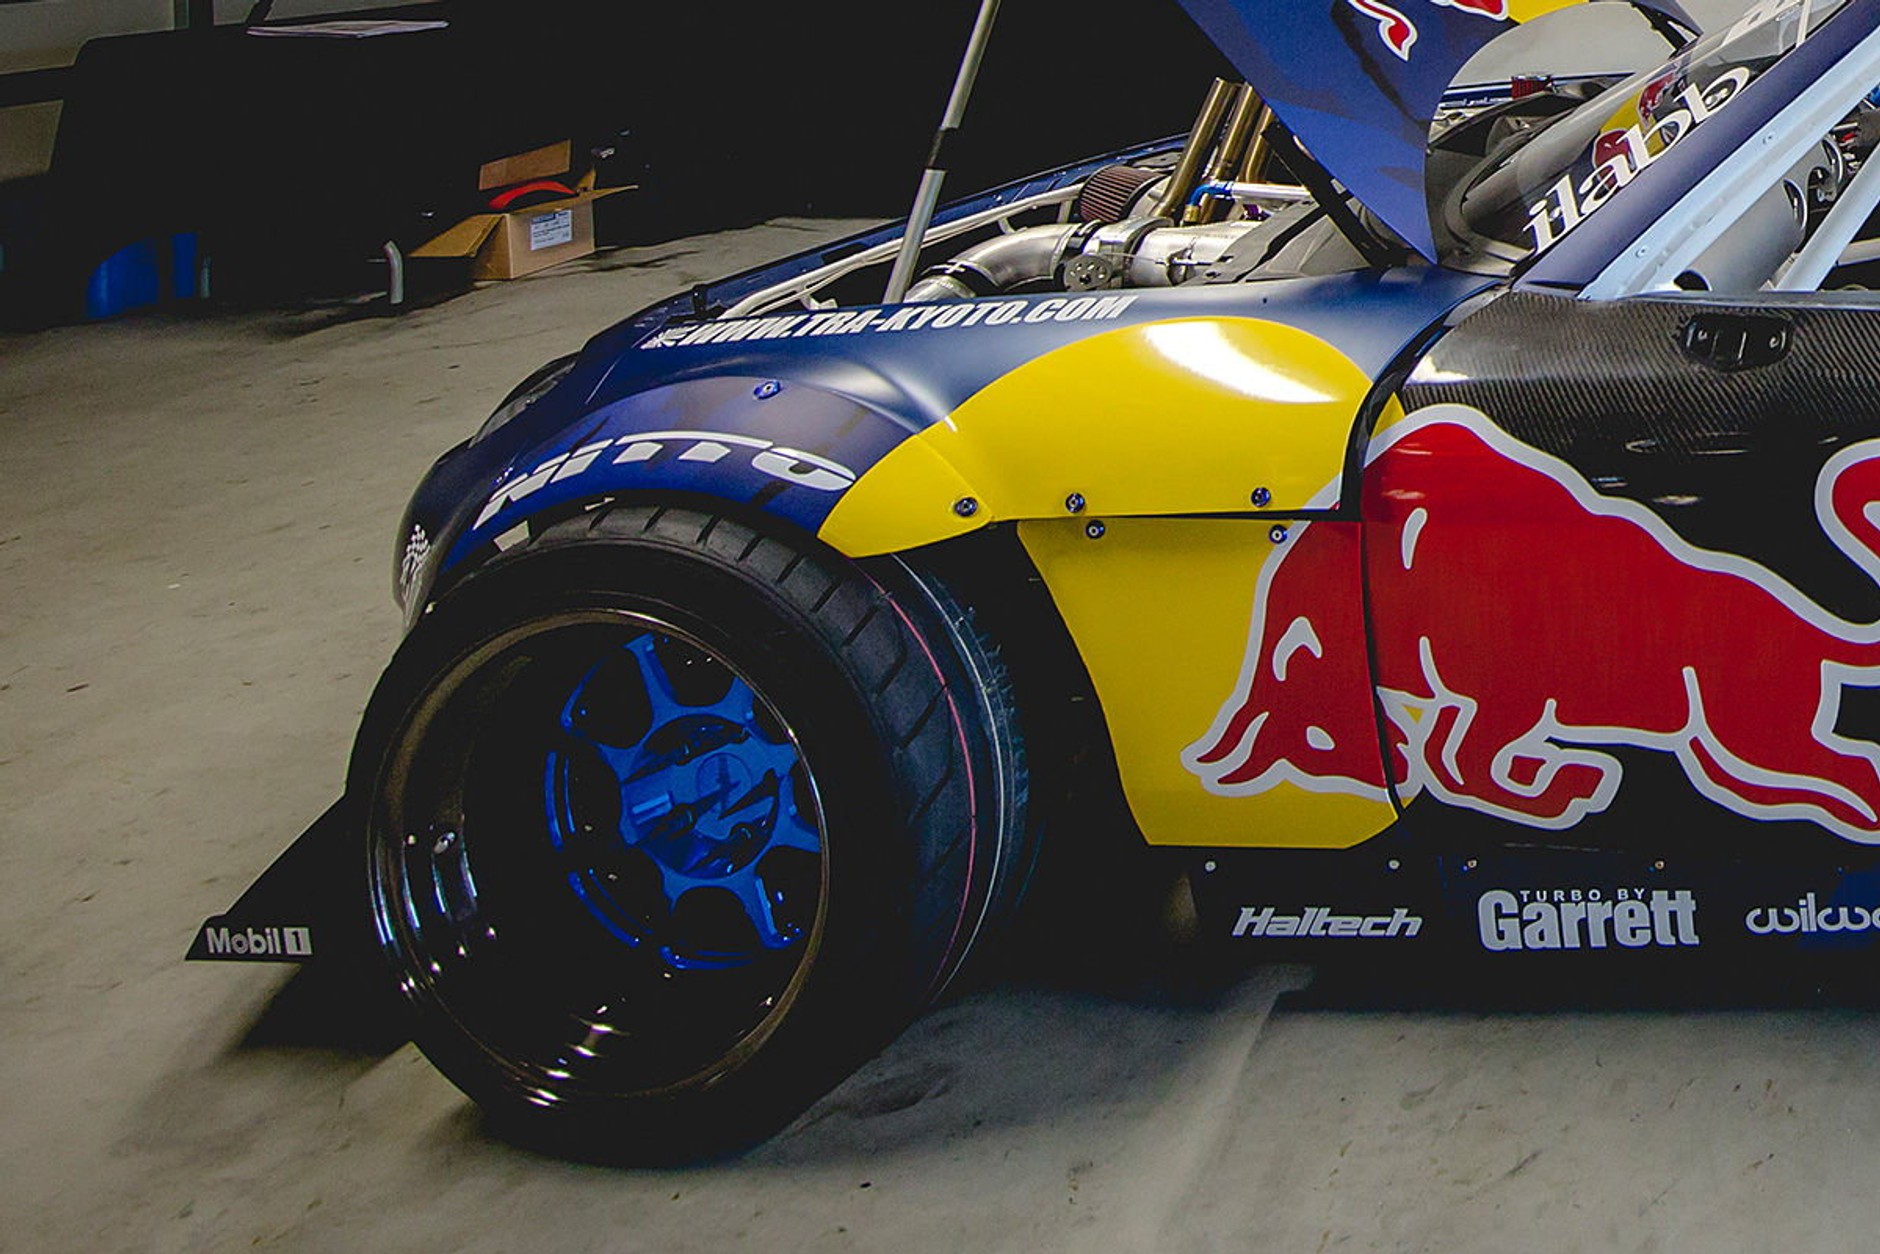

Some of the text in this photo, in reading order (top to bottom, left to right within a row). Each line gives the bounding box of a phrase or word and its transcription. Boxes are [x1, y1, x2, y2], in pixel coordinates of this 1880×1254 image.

[1523, 66, 1750, 253] ilabb
[677, 296, 1138, 346] WWW.TRA-KYOTO.COM
[473, 431, 856, 530] NITTO
[1478, 889, 1700, 951] Garrett
[1519, 888, 1645, 902] TURBO BY
[206, 927, 281, 954] Mobil
[1232, 906, 1423, 937] Haltech
